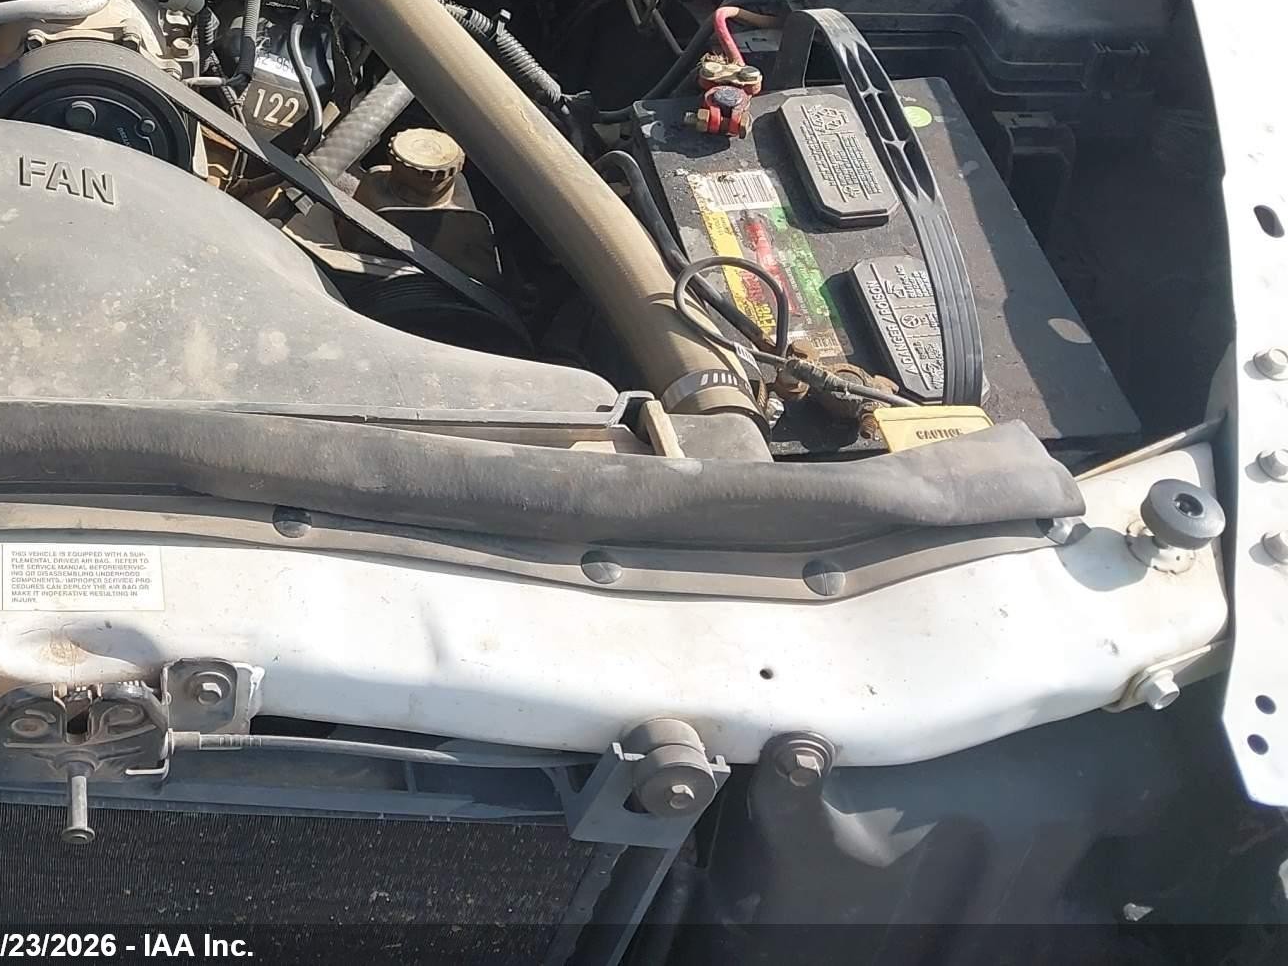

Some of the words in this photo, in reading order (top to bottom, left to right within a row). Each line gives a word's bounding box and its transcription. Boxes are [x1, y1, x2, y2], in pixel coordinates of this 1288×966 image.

[252, 88, 299, 128] 122
[19, 153, 115, 205] FAN
[866, 281, 893, 316] POISON
[886, 325, 912, 365] DANGER
